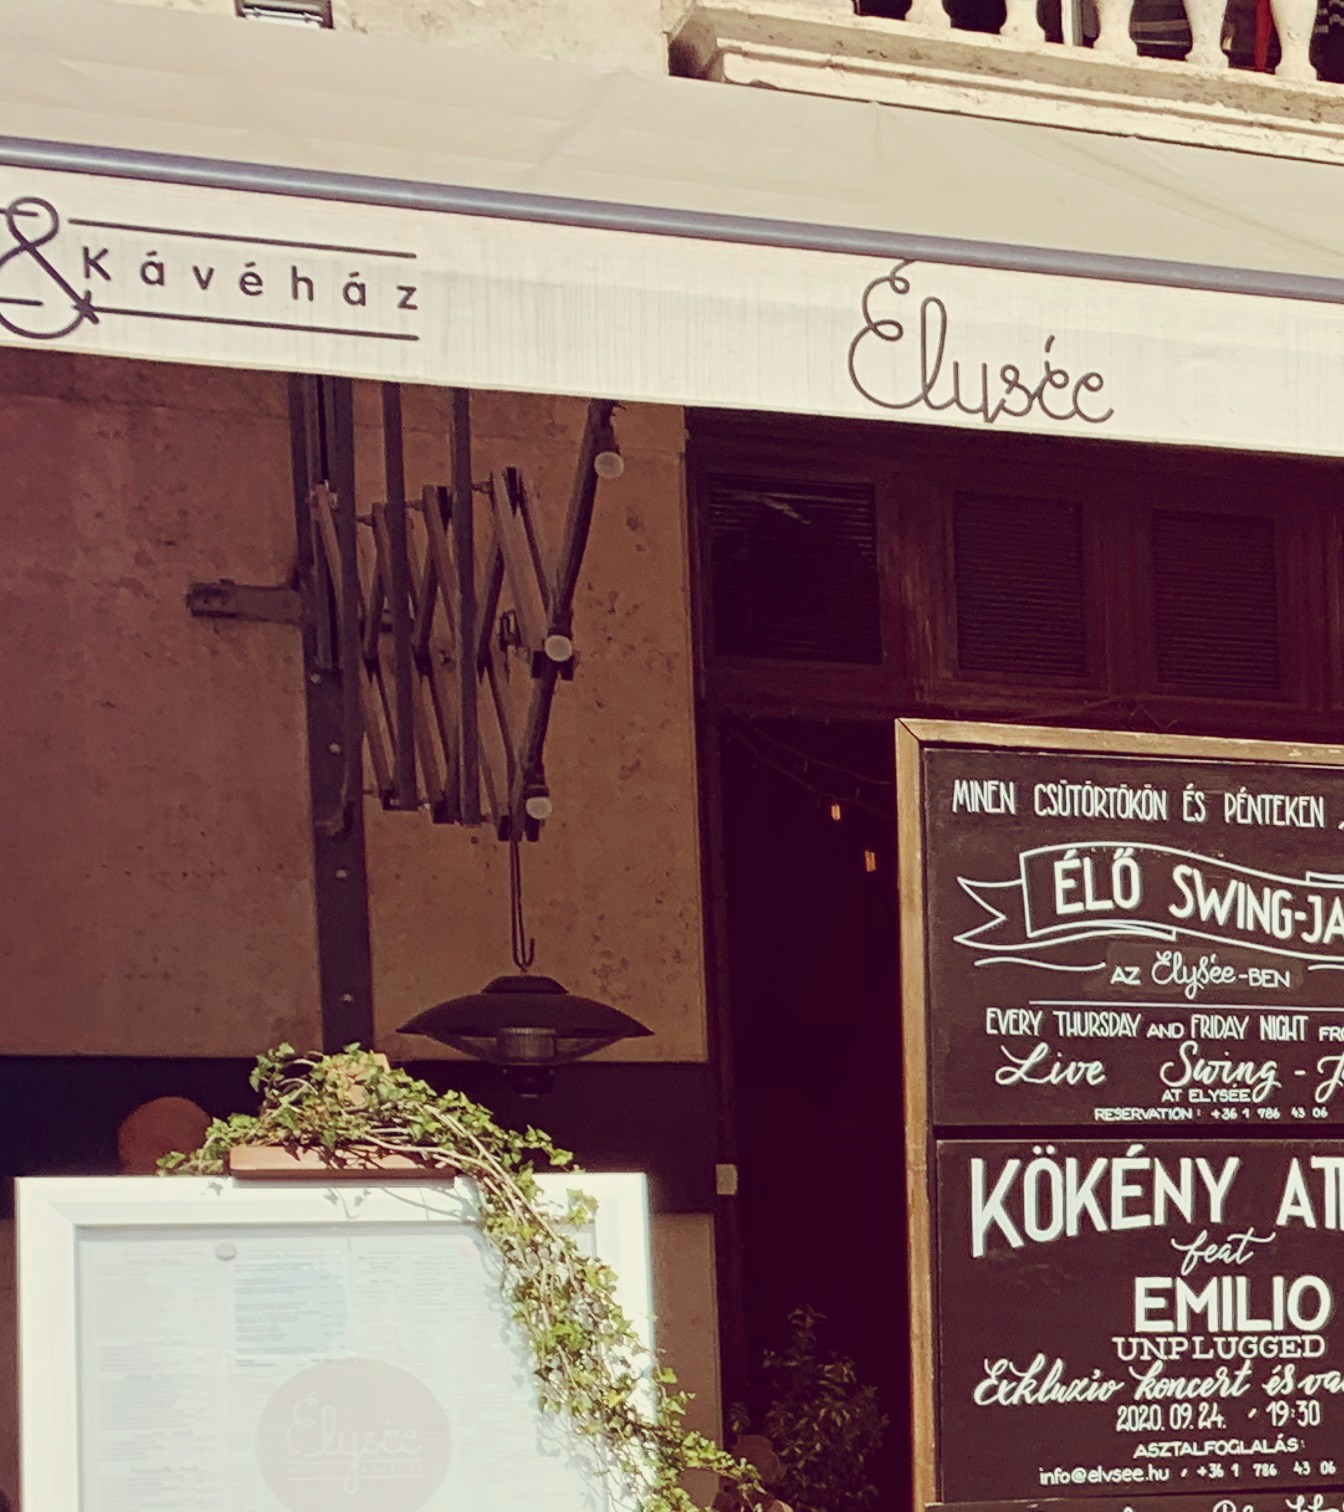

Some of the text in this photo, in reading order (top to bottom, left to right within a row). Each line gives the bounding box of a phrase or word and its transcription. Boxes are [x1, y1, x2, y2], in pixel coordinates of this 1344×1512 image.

[82, 247, 419, 311] Kávéház
[952, 779, 1016, 815] MINEN
[1183, 784, 1206, 822] ÉS
[1224, 787, 1324, 827] PÉNTEKEN
[1052, 848, 1142, 914] ÉLŐ
[1110, 966, 1141, 985] AZ
[986, 1008, 1042, 1036] EVERY
[1052, 1011, 1141, 1039] THURSDAY
[1146, 1023, 1184, 1040] AND
[1190, 1015, 1249, 1041] FRIDAY
[1260, 1016, 1308, 1042] NIGHT
[994, 1042, 1106, 1086] Live
[1159, 1041, 1282, 1102] Swing
[1161, 1089, 1184, 1102] AT
[1211, 1108, 1237, 1121] +36
[971, 1144, 1240, 1258] KÖKÉNY
[1171, 1228, 1276, 1276] feat
[1135, 1275, 1332, 1332] EMILIO
[1112, 1335, 1326, 1360] UNPLUGGED
[1129, 1360, 1252, 1400] koncert
[1262, 1368, 1295, 1397] és
[1265, 1400, 1321, 1427] 19:30
[1197, 1462, 1225, 1478] +36
